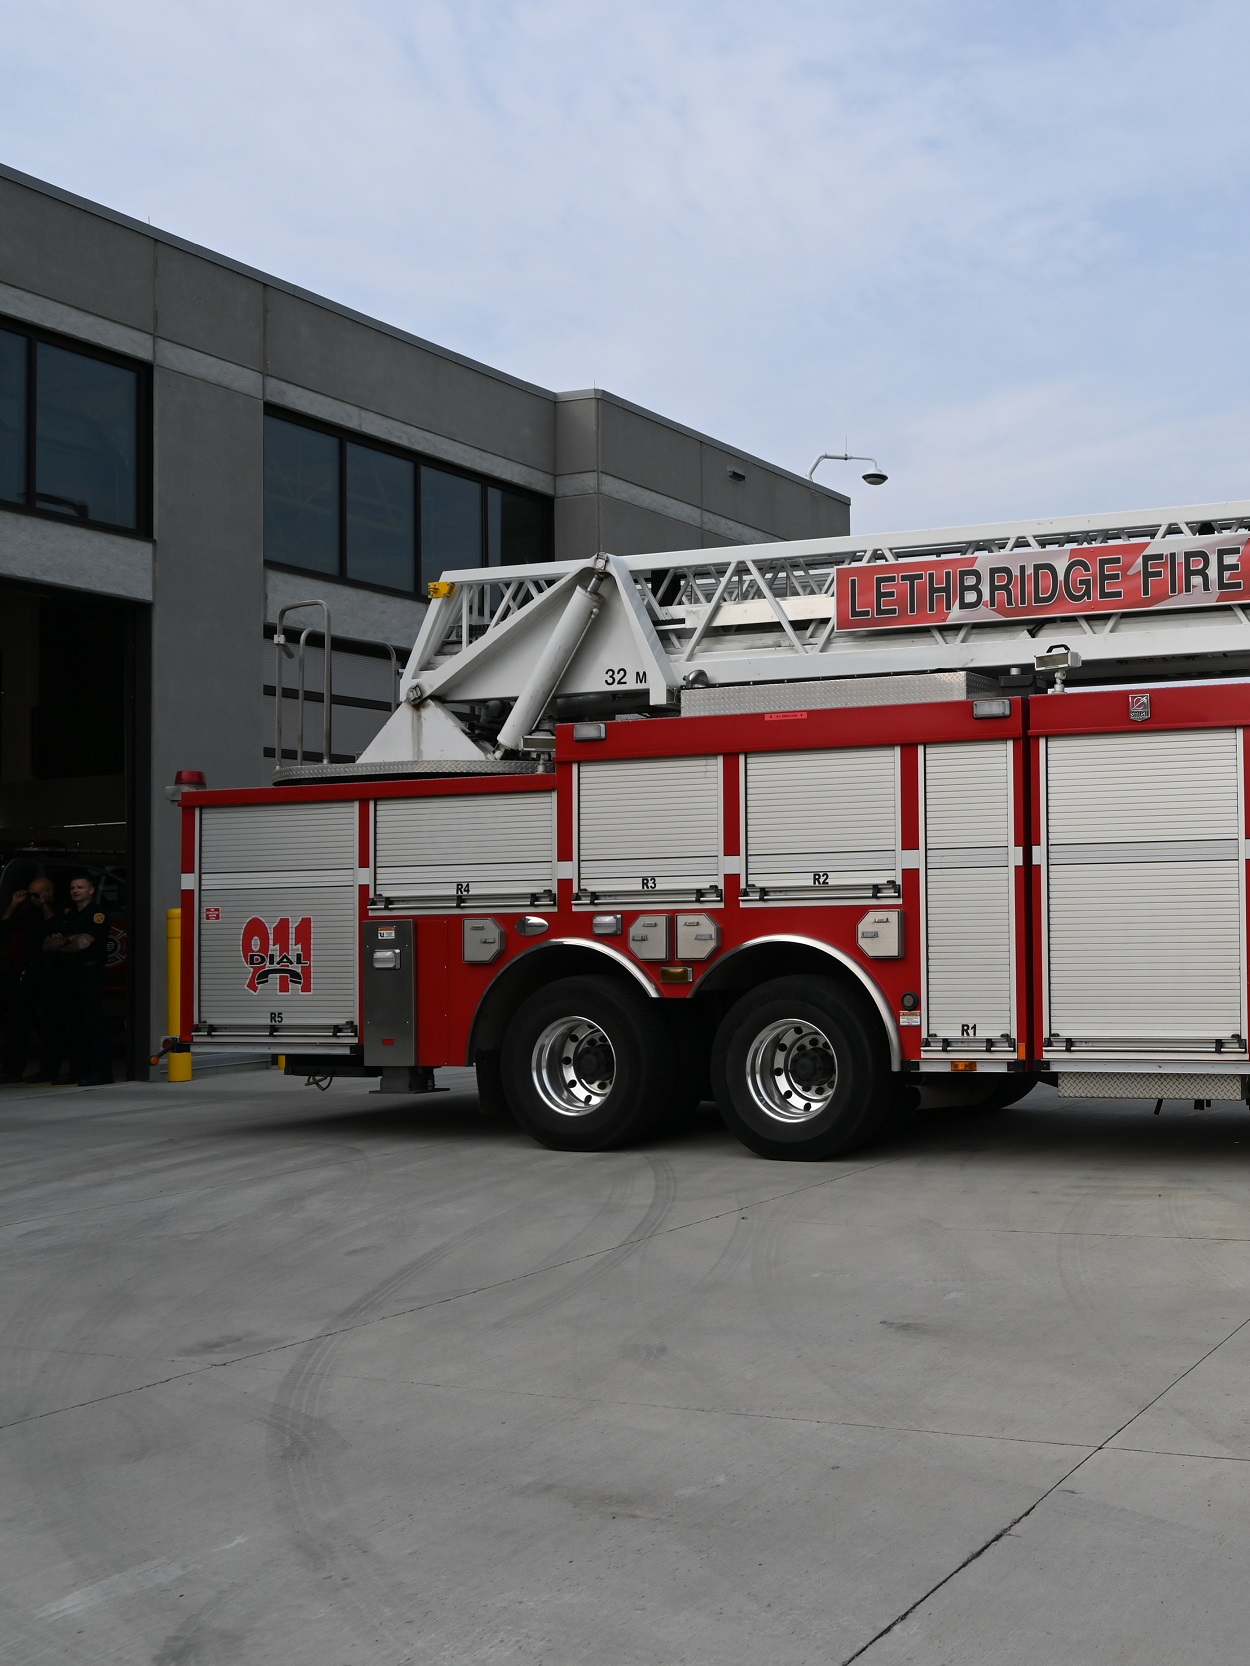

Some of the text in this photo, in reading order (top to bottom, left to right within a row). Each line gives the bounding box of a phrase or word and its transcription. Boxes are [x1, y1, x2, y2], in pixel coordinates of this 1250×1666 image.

[848, 555, 1123, 620] LETHBRIDGE
[1140, 546, 1243, 597] FIRE
[604, 668, 647, 686] 32 M
[641, 877, 657, 890] R3
[813, 873, 829, 886] R2
[456, 883, 471, 895] R4
[241, 916, 313, 994] 911
[248, 953, 310, 966] DIAL
[270, 1012, 283, 1024] R5
[961, 1024, 977, 1037] R1
